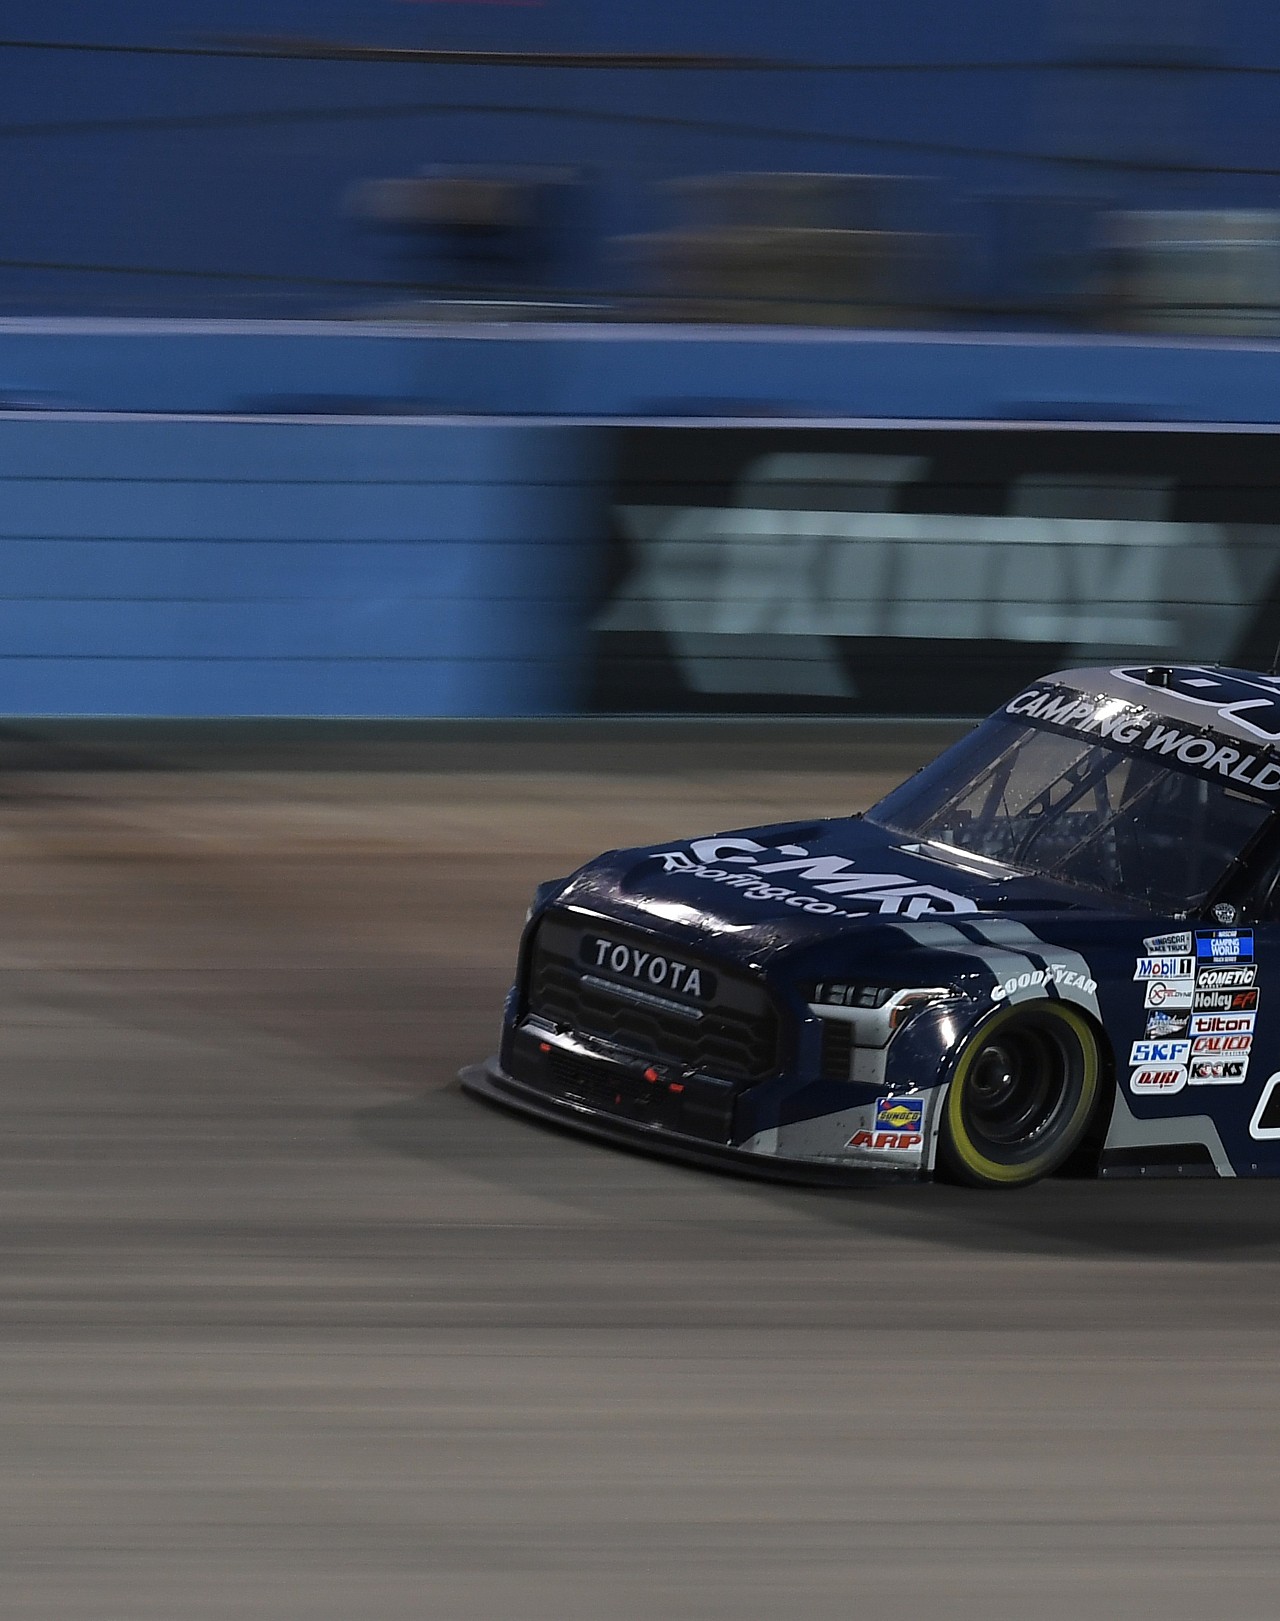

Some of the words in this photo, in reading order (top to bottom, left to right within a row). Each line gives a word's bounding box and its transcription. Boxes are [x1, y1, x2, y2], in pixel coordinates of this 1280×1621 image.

[1006, 690, 1150, 744] CAMPING
[1210, 938, 1240, 947] CAMPING
[1211, 945, 1240, 956] WORLD
[596, 939, 702, 997] TOYOTA
[1139, 958, 1176, 975] Mobil
[990, 963, 1098, 1002] GOODYEAR
[1198, 967, 1254, 986] COMETIC
[1194, 992, 1233, 1011] Holley
[1195, 1017, 1251, 1032] tilton
[1132, 1043, 1188, 1061] SKF
[1194, 1036, 1251, 1051] CALICO
[1190, 1061, 1244, 1079] KOOKS
[879, 1111, 921, 1121] SUNOCO
[850, 1132, 922, 1149] ARP
